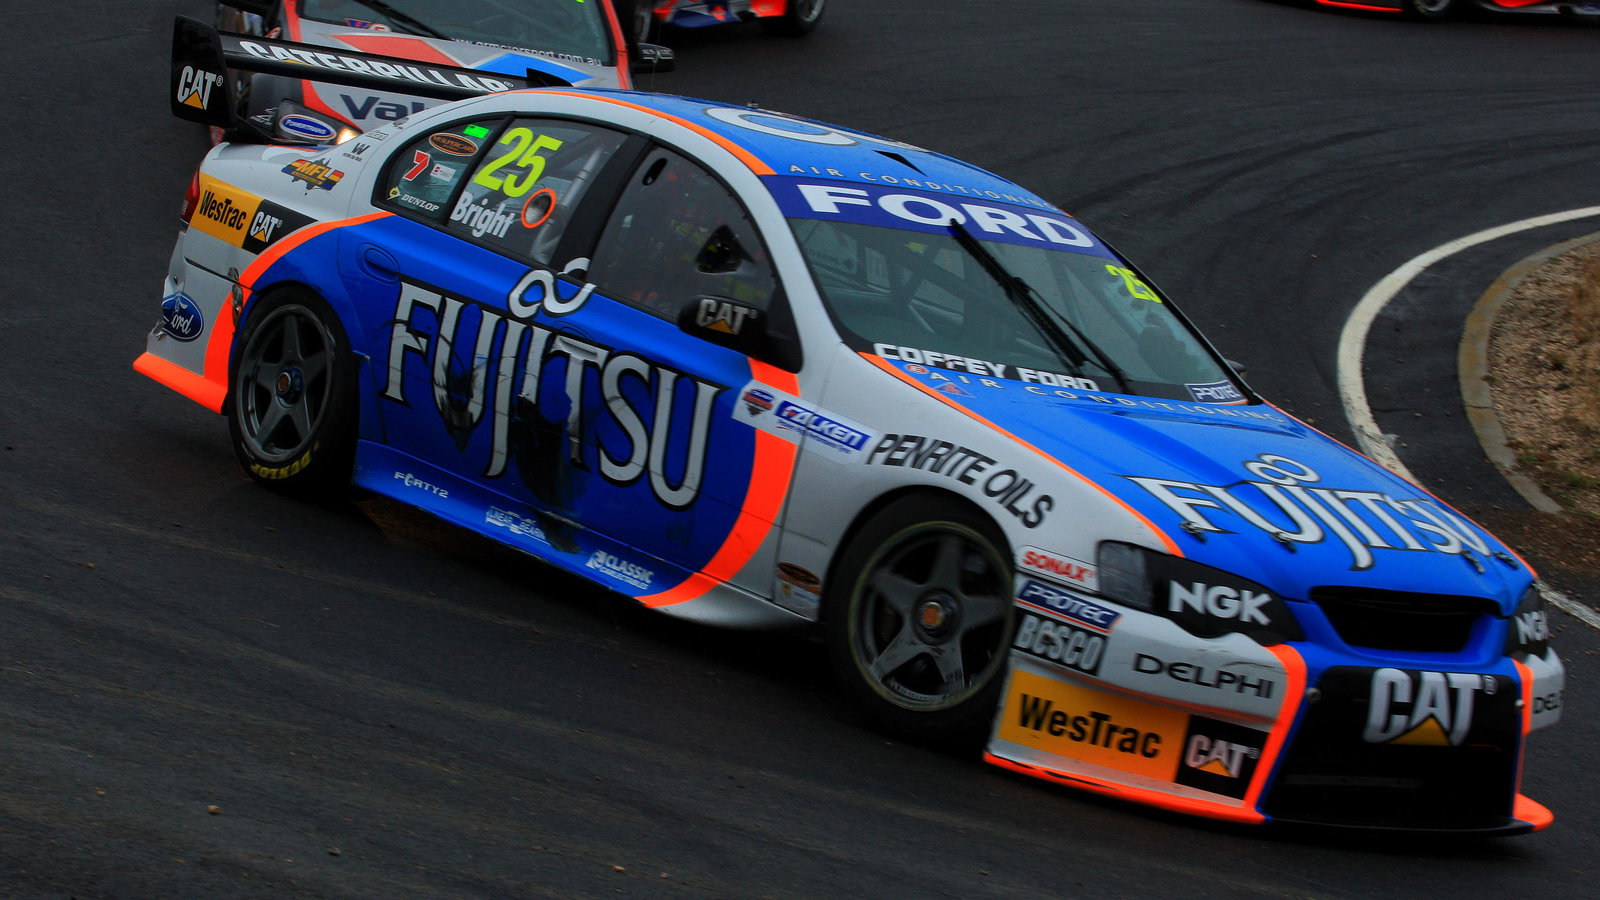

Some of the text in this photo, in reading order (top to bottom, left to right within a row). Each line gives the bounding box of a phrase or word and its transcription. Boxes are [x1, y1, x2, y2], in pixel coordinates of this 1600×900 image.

[177, 65, 218, 110] CAT
[240, 41, 510, 92] CATERPILLAR
[296, 161, 331, 181] MFL
[472, 126, 564, 198] 25
[790, 165, 846, 178] AIR
[199, 189, 247, 231] WesTrac
[250, 211, 279, 243] CAT
[401, 194, 439, 212] DUNLOP
[450, 191, 515, 238] Bright
[796, 184, 1095, 248] FORD
[1105, 264, 1162, 304] 25
[695, 298, 748, 335] CAT
[873, 342, 1100, 392] COFFEY FORD
[385, 281, 721, 507] FUJITSU
[929, 372, 1284, 422] AIR CONDITIONING
[781, 405, 863, 447] FALKEN
[394, 471, 450, 498] FORTY2
[865, 433, 998, 486] PENRITE
[983, 468, 1056, 528] OILS
[1115, 475, 1493, 571] FUJITSU
[603, 554, 655, 584] CLASSIC
[1023, 551, 1089, 582] SONAX
[1023, 584, 1115, 627] PROTEC
[1168, 580, 1273, 626] NGK
[1514, 611, 1549, 645] NG
[1133, 653, 1274, 699] DELPHI
[1362, 667, 1481, 747] CAT
[1020, 693, 1249, 780] WesTrac CAT
